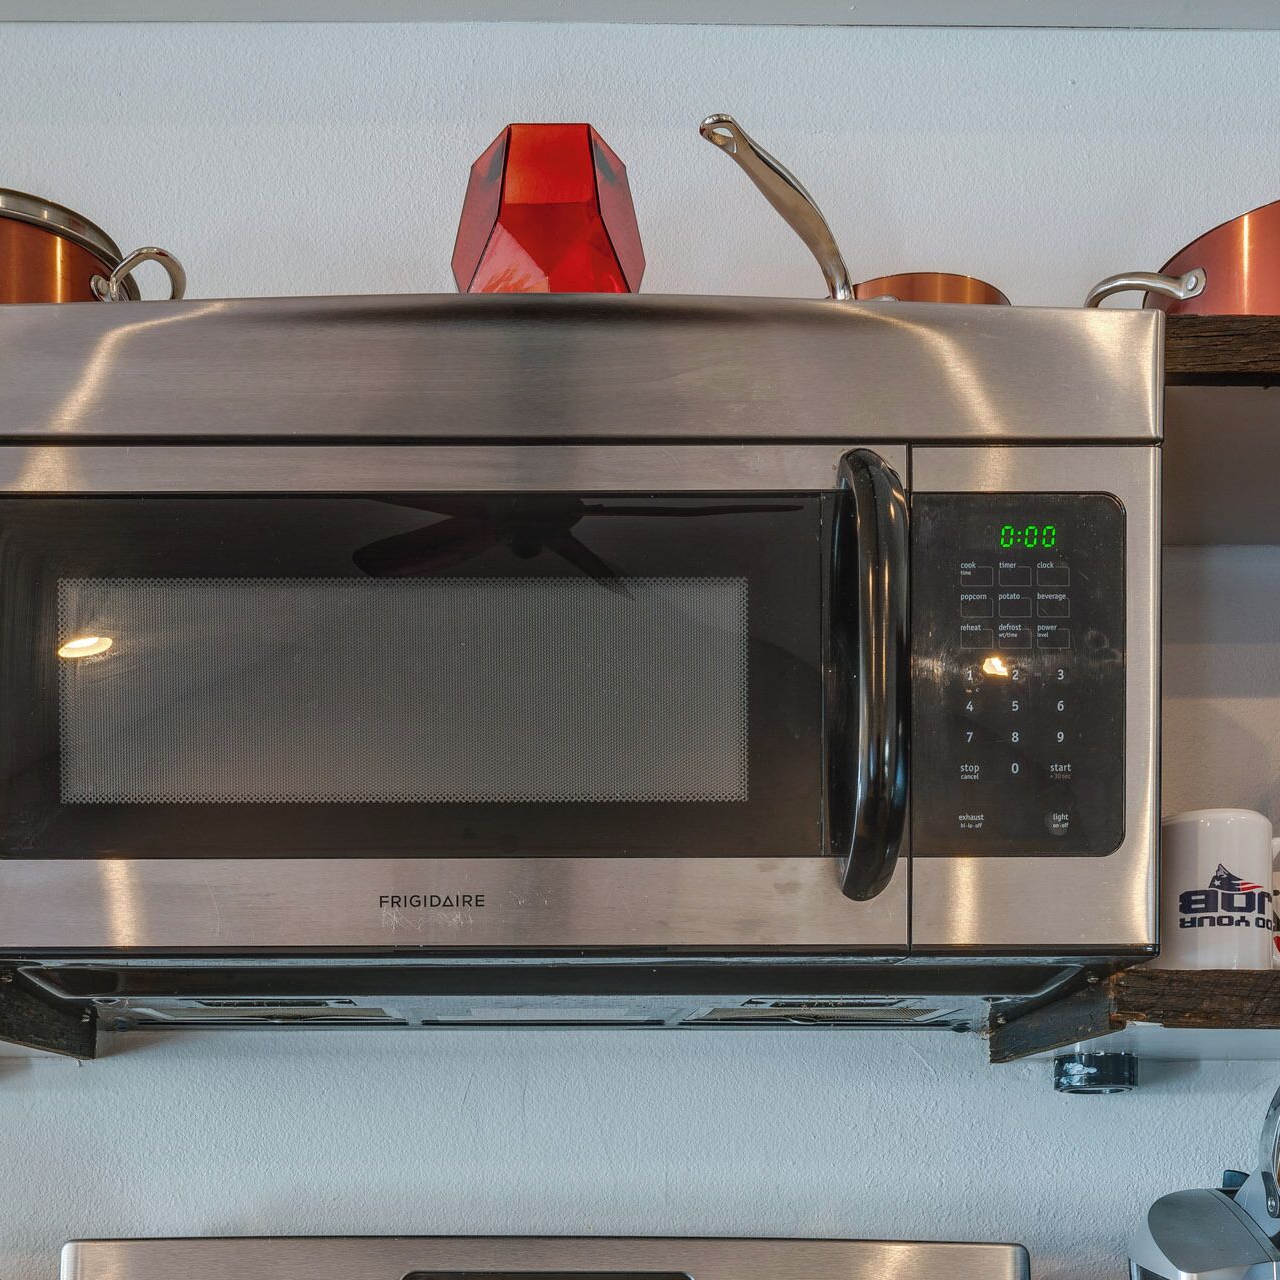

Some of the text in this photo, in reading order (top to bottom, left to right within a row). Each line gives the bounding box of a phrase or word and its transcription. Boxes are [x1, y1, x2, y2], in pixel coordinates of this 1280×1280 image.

[1000, 525, 1057, 548] 0:00
[961, 594, 987, 602] popcorn
[999, 593, 1021, 601] potato
[1037, 592, 1066, 601] beverage
[966, 670, 973, 680] 1
[1012, 670, 1019, 680] 2
[1057, 670, 1064, 680] 3
[966, 701, 973, 711] 4
[1012, 701, 1019, 711] 5
[1057, 701, 1064, 711] 6
[966, 732, 973, 743] 7
[1012, 732, 1019, 743] 8
[1057, 732, 1064, 743] 9
[961, 764, 979, 773] stop
[1011, 763, 1019, 774] 0
[1050, 763, 1072, 772] start
[1052, 813, 1069, 822] light
[379, 895, 485, 908] FRIGIDAIRE
[1179, 889, 1272, 914] JOB
[1179, 916, 1250, 928] YOUR
